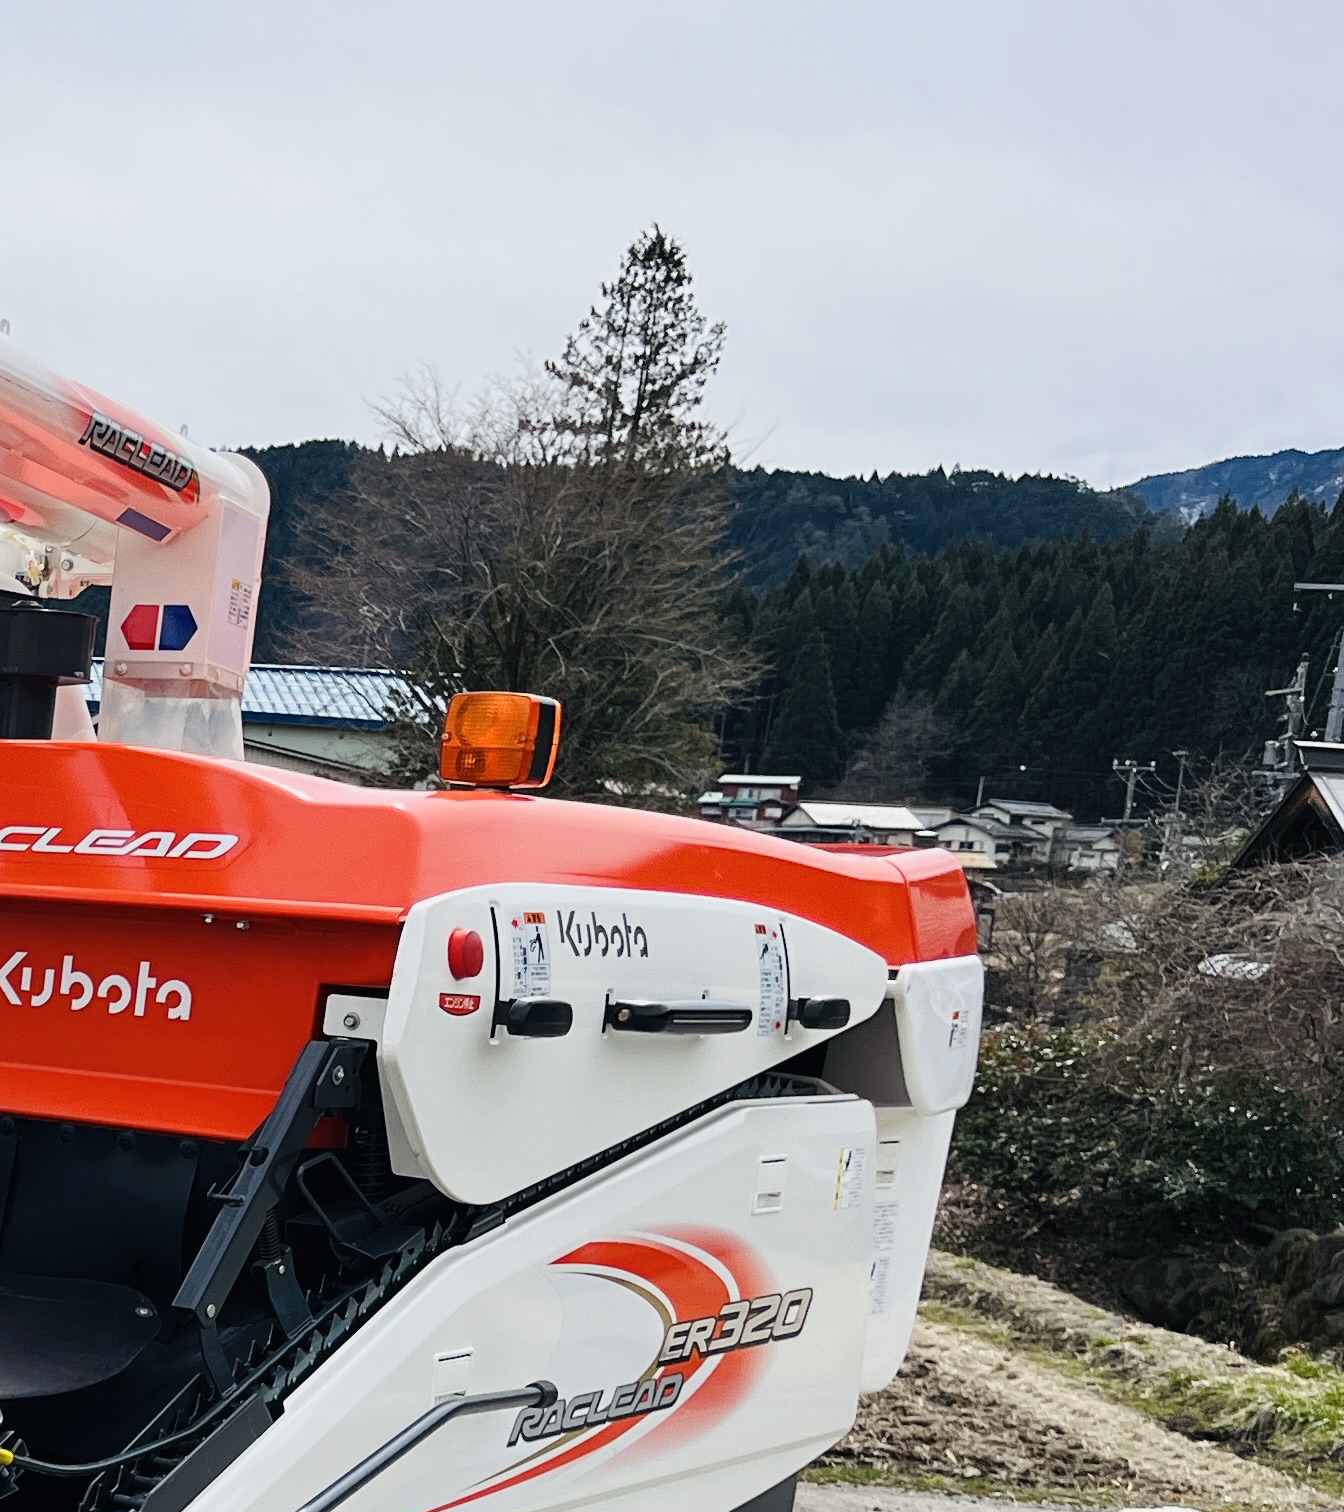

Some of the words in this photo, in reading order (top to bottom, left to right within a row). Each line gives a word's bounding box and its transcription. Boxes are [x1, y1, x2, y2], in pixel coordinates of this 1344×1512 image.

[78, 411, 194, 492] RACLEAD
[556, 910, 649, 958] Kubota
[657, 1287, 814, 1368] ER320
[506, 1372, 686, 1448] RACLEAD
